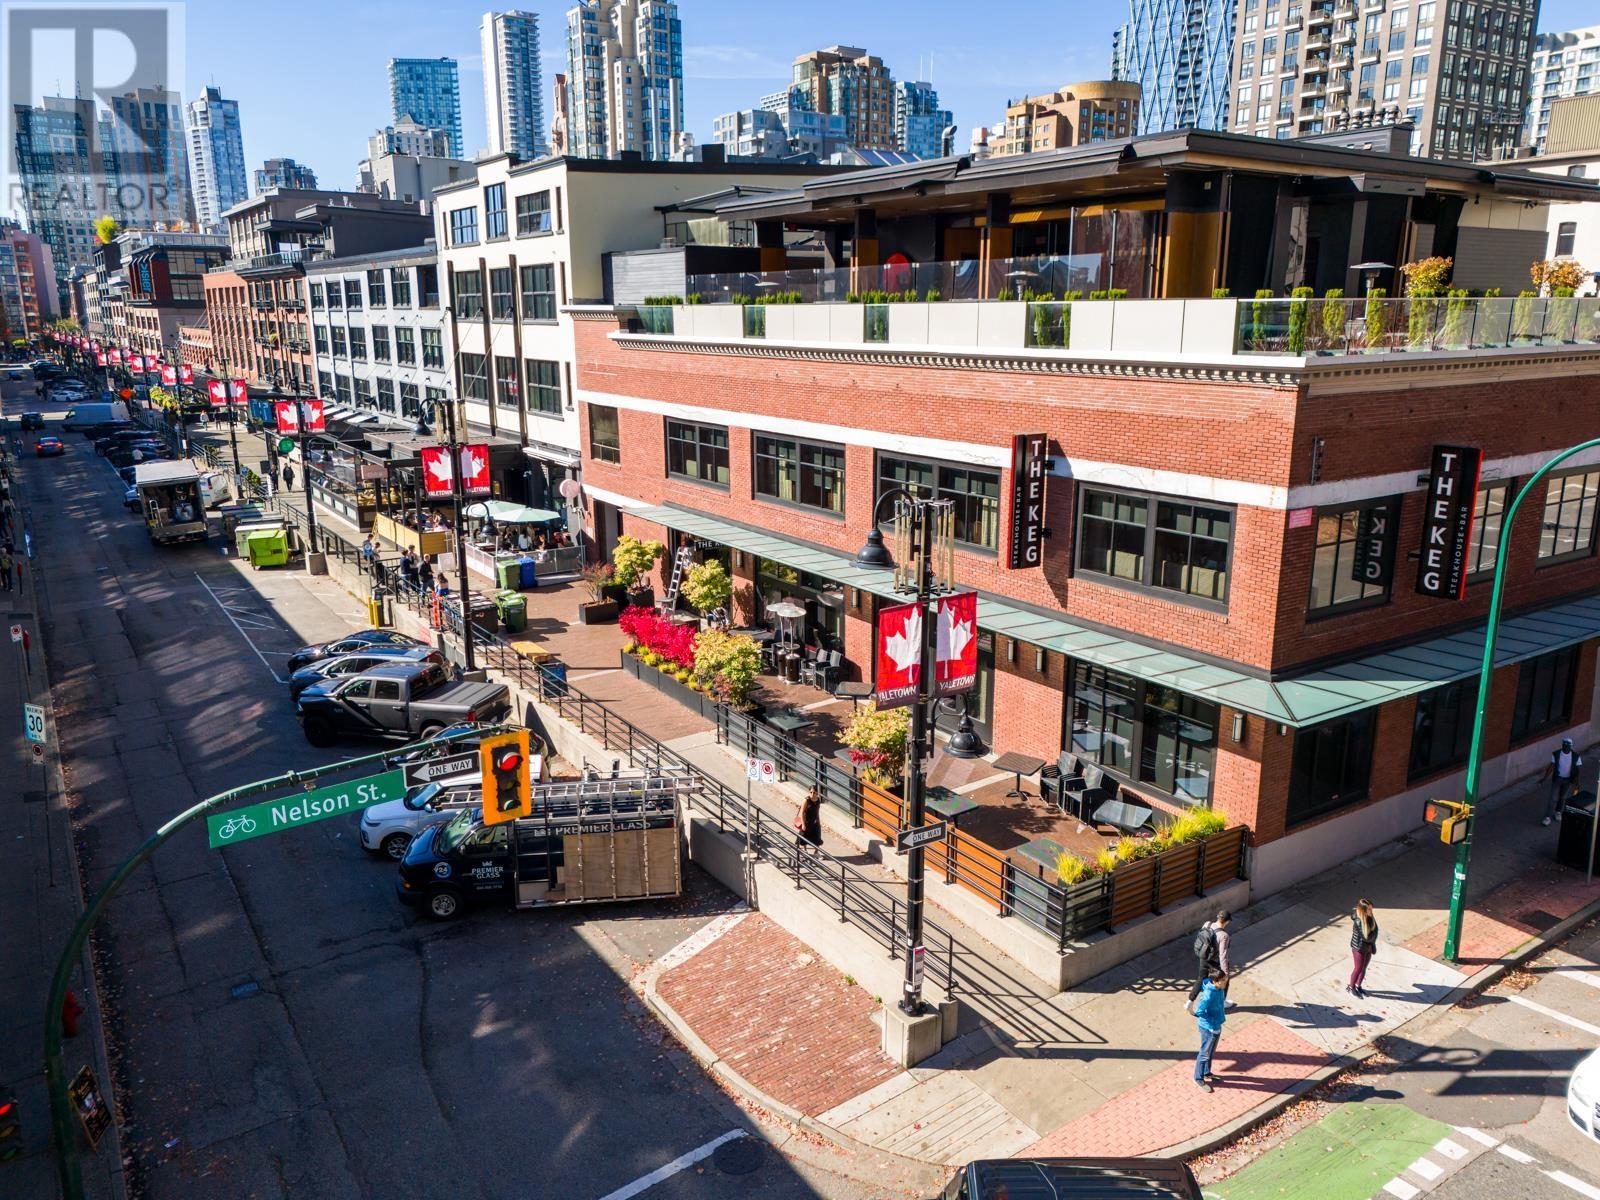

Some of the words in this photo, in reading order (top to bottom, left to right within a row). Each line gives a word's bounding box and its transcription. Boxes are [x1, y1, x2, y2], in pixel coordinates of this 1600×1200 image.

[1029, 440, 1042, 499] THE
[1434, 453, 1457, 519] THE
[1026, 505, 1040, 562] KEG
[1424, 526, 1447, 591] KEG
[940, 674, 976, 690] YALETOWN
[878, 685, 917, 701] YALETOWN
[28, 715, 43, 732] 30
[428, 764, 447, 776] ONE
[451, 760, 470, 771] WAY
[272, 794, 349, 826] Nelson
[356, 784, 387, 804] St.
[555, 823, 609, 836] PREMIER
[913, 832, 926, 842] ONE
[927, 828, 940, 837] WAY
[471, 866, 504, 875] PREMIER
